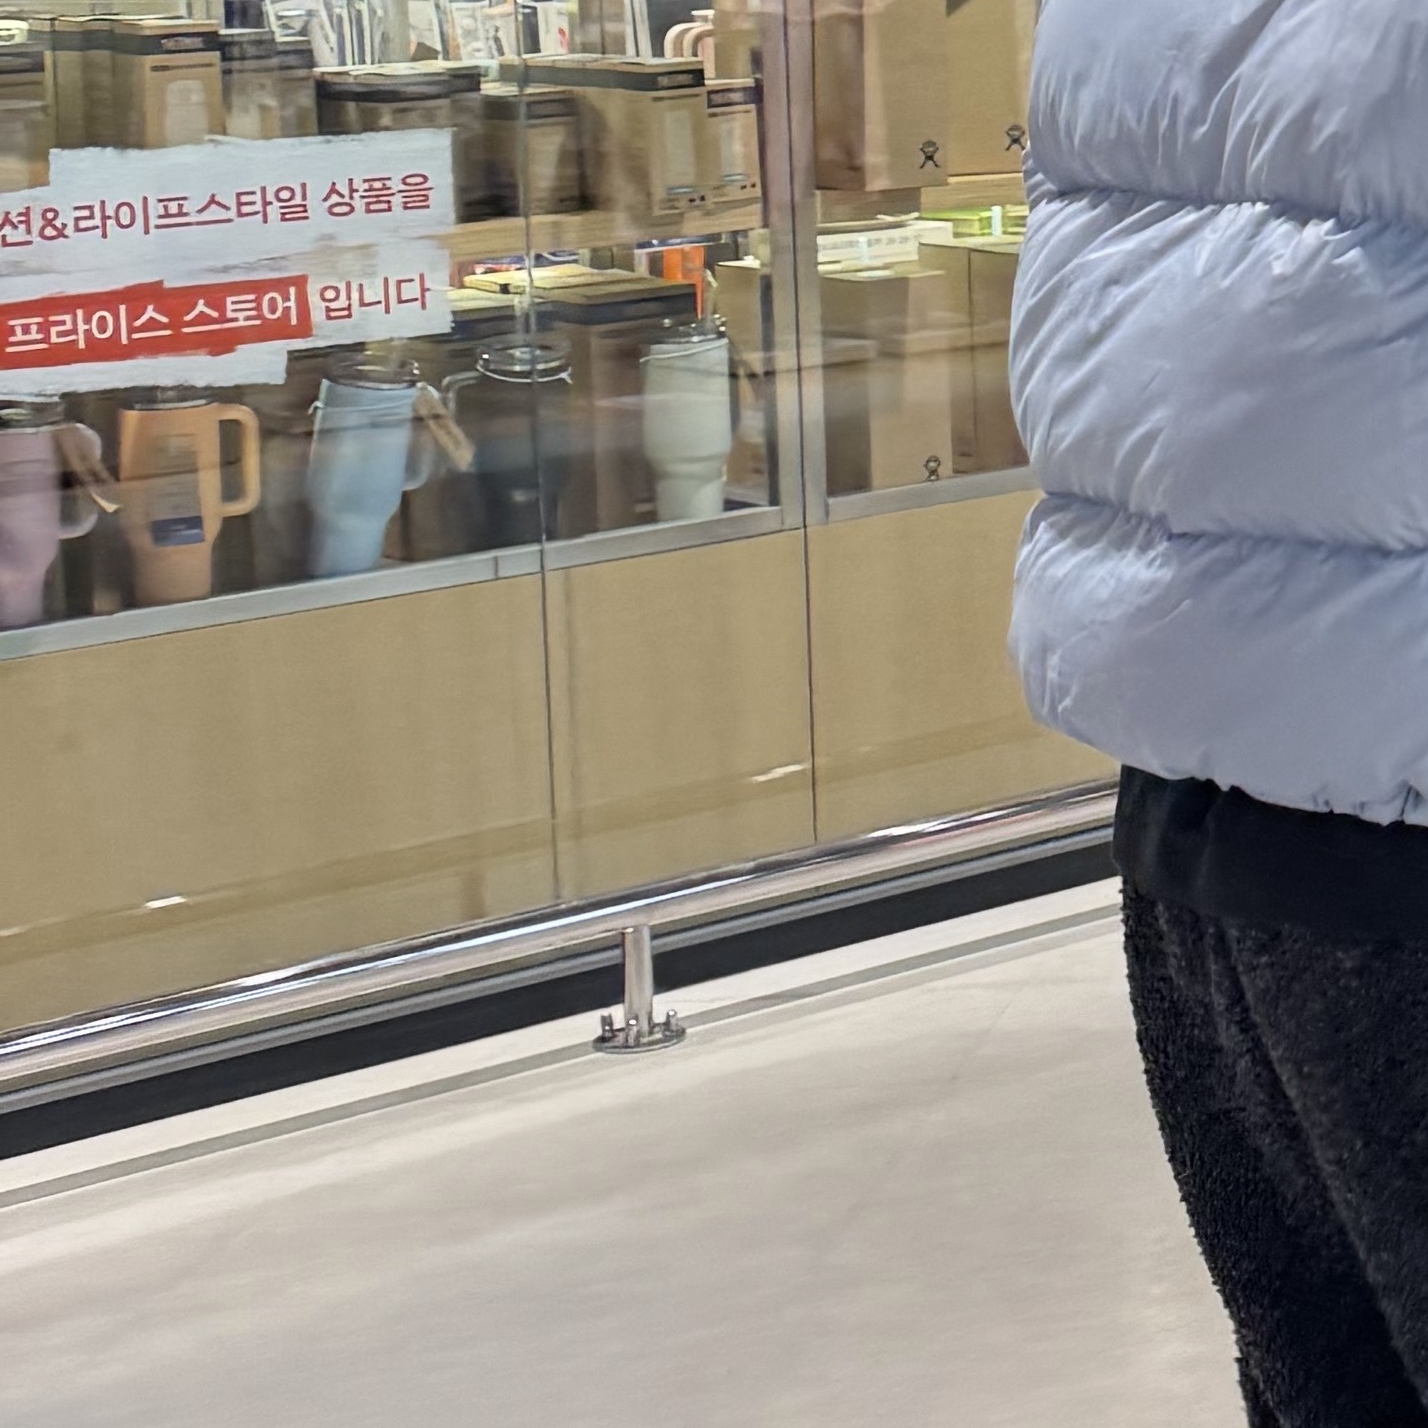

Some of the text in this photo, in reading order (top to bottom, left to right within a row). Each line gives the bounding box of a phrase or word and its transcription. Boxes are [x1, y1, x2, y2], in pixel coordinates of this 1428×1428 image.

[0, 172, 435, 248] 션&라이프스타일 상품을
[6, 272, 433, 353] 프라이스 스토어 입니다
